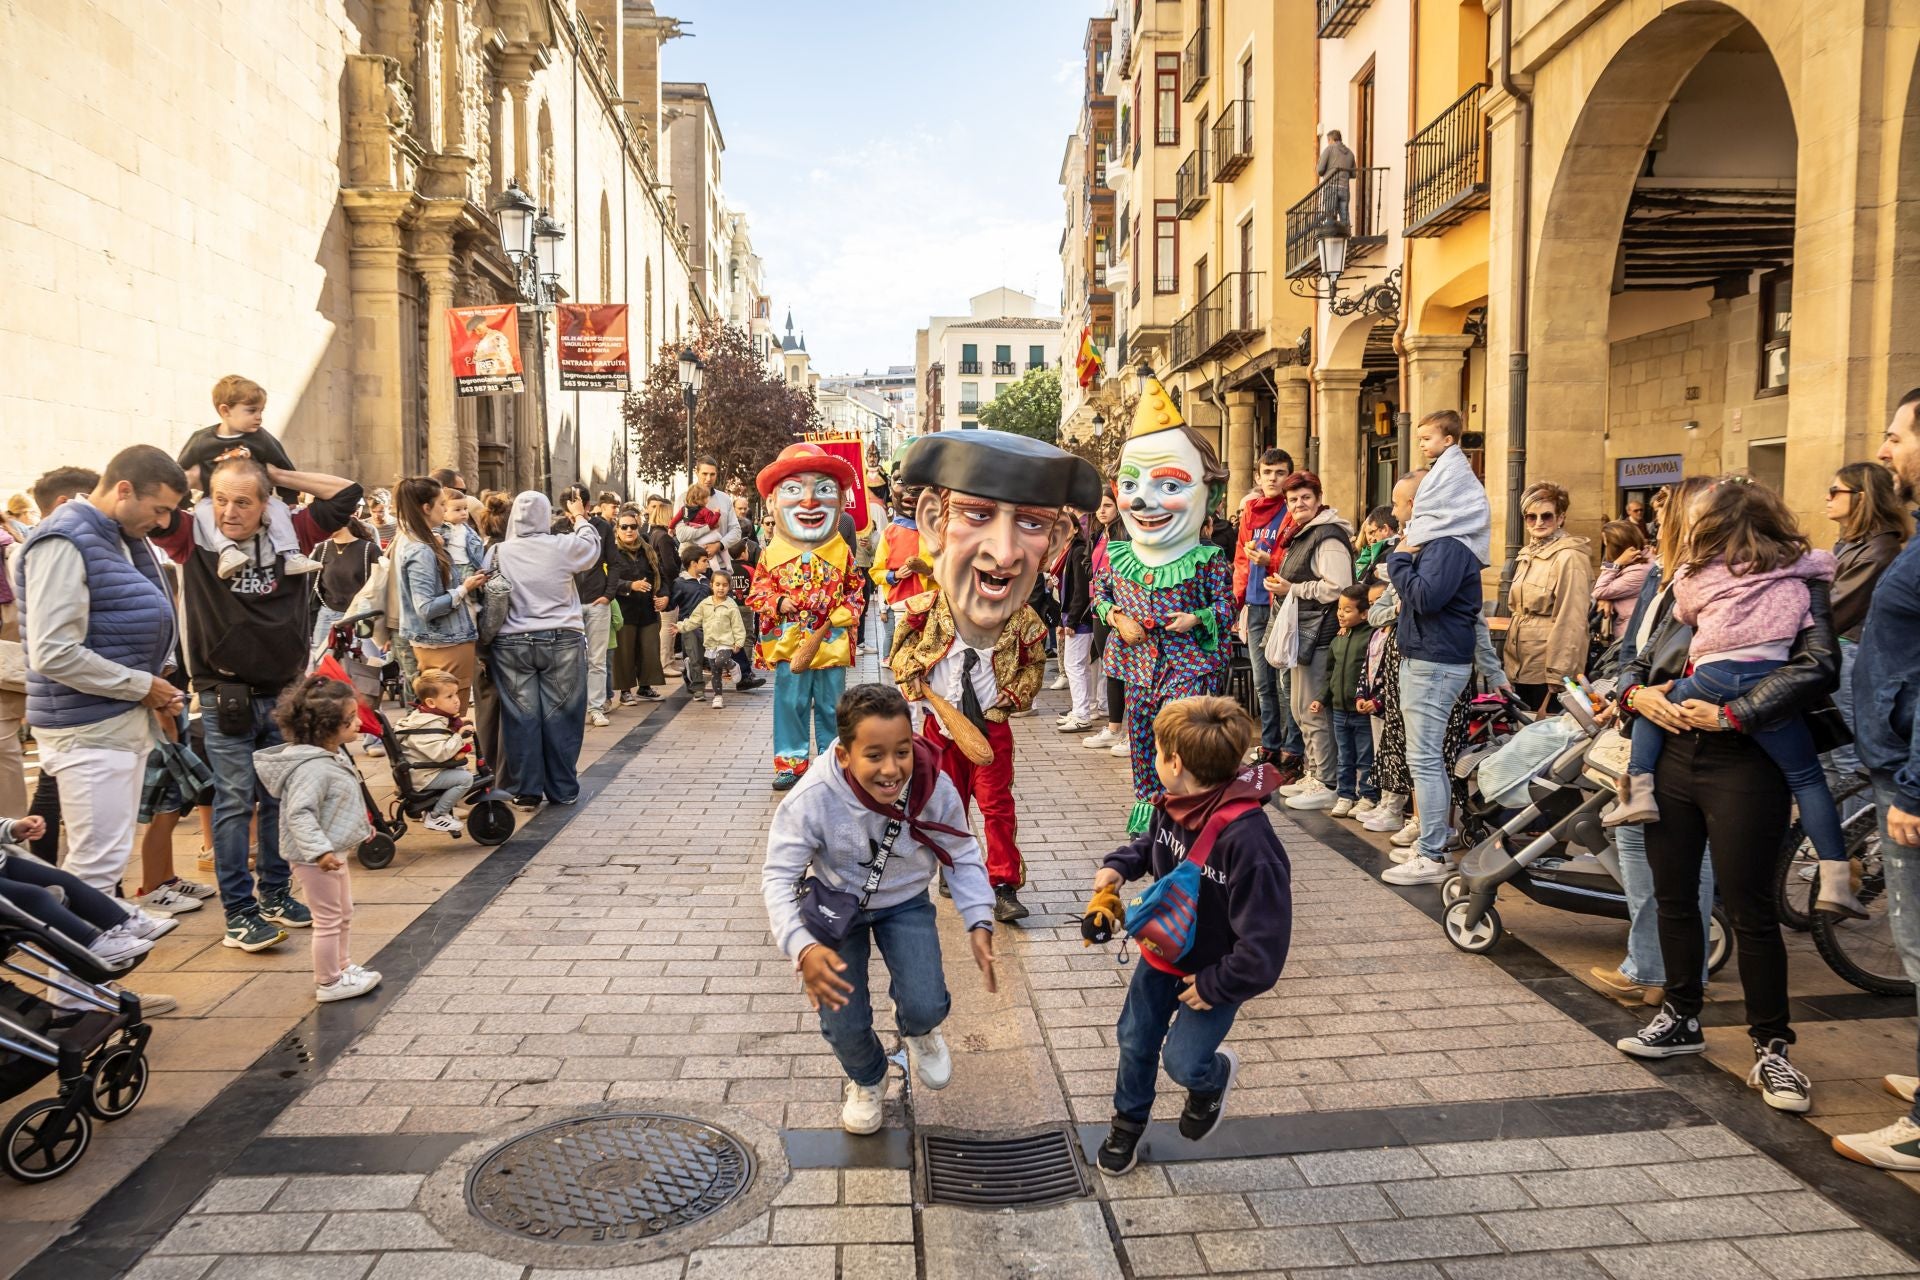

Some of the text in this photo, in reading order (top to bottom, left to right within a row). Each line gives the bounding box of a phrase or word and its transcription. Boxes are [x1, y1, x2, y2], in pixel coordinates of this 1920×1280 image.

[561, 359, 593, 367] ENTRADA
[1624, 463, 1635, 477] LA
[231, 577, 272, 594] ZERO
[874, 848, 889, 870] NIKE
